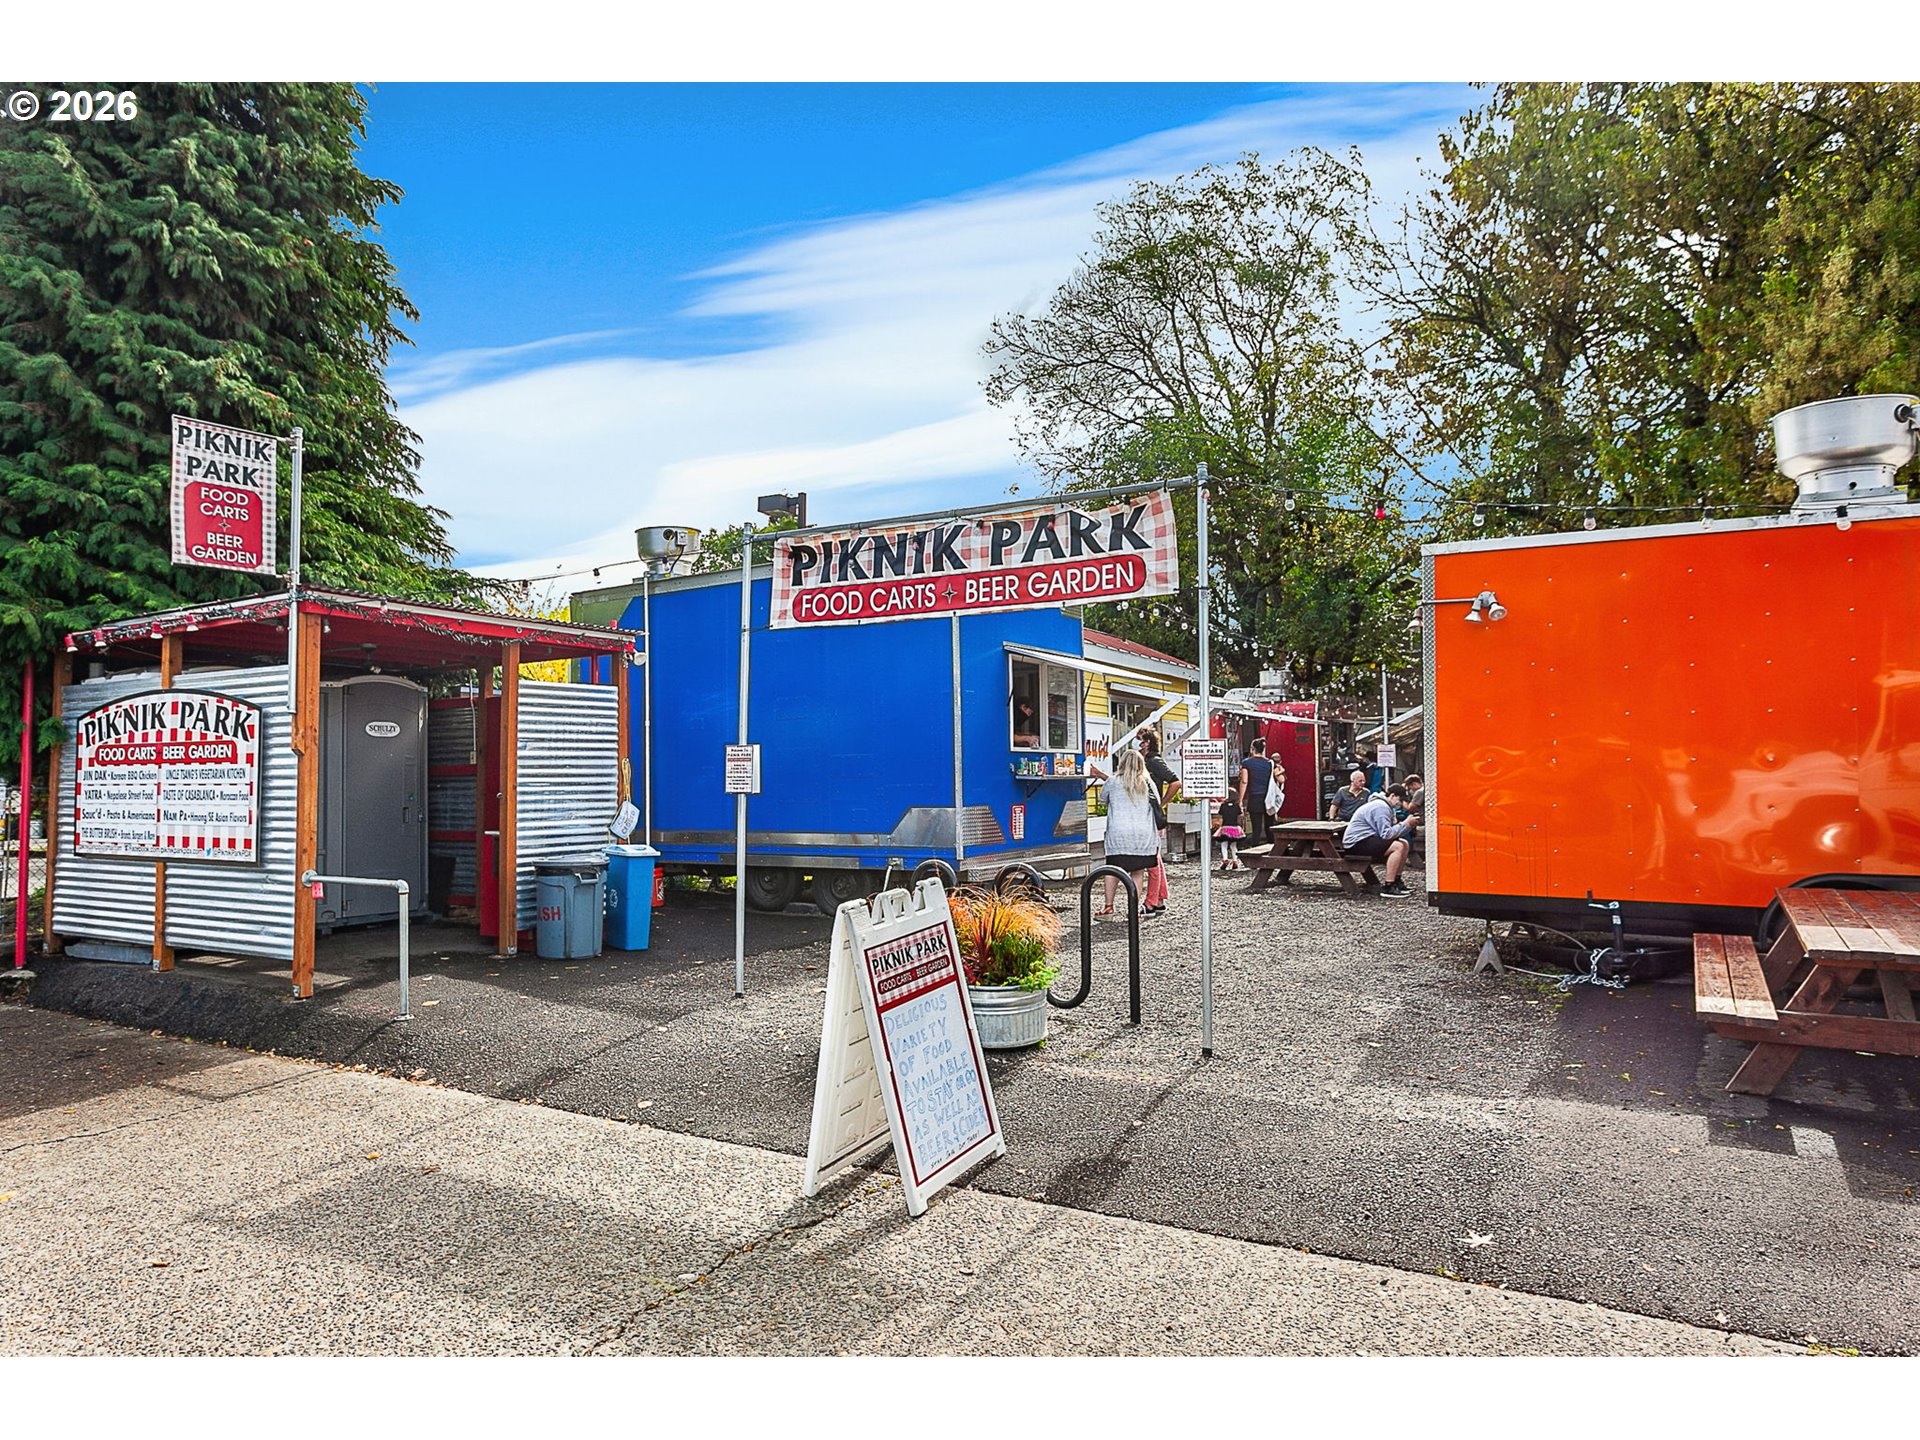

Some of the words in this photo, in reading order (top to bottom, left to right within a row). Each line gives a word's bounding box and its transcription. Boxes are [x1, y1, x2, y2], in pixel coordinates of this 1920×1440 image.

[177, 425, 271, 462] PIKNIK
[187, 455, 260, 488] PARK
[200, 502, 249, 521] CARTS
[201, 487, 249, 505] FOOD
[192, 545, 257, 565] GARDEN
[207, 532, 243, 549] BEER
[789, 524, 969, 587] PIKNIK
[990, 504, 1152, 566] PARK
[801, 590, 862, 618] FOOD
[869, 585, 936, 613] CARTS
[965, 577, 1019, 605] BEER
[1027, 561, 1135, 598] GARDEN
[84, 701, 168, 748] PIKNIK
[179, 701, 253, 742] PARK
[99, 747, 125, 761] FOOD
[127, 746, 157, 760] CARTS
[162, 745, 185, 759] BEER
[188, 744, 232, 758] GARDEN
[1086, 733, 1110, 761] auc'd
[94, 770, 107, 780] DAK
[111, 771, 126, 780] Korean
[128, 770, 137, 780] BBQ
[139, 770, 157, 780] Chicken
[227, 768, 246, 779] KITCHEN
[84, 789, 102, 800] YATRA
[107, 790, 127, 802] Nepalese
[128, 790, 141, 800] Street
[142, 790, 153, 800] Food
[163, 789, 176, 801] TASTE
[177, 789, 184, 800] OF
[185, 789, 216, 801] CASABLANCA
[239, 790, 248, 801] Food
[82, 808, 102, 819] Sauc'd
[106, 810, 120, 819] Pasta
[122, 810, 126, 819] &
[127, 810, 155, 820] Americana
[208, 812, 214, 822] SE
[215, 812, 228, 822] Asian
[229, 812, 247, 822] Flavors
[872, 945, 914, 975] PIKNIK
[915, 933, 947, 958] PARK
[880, 978, 899, 992] FOOD
[899, 971, 913, 986] CARTS
[916, 966, 928, 978] BEER
[928, 957, 948, 972] GARDEN
[884, 993, 948, 1035] DELICIOUS
[890, 1016, 947, 1058] VARIETY
[899, 1054, 915, 1077] OF
[922, 1038, 953, 1064] FOOD
[903, 1050, 968, 1102] AVAILABLE
[915, 1119, 930, 1143] AS
[934, 1099, 963, 1127] WELL
[967, 1088, 979, 1110] AS
[918, 1129, 954, 1166] BEER
